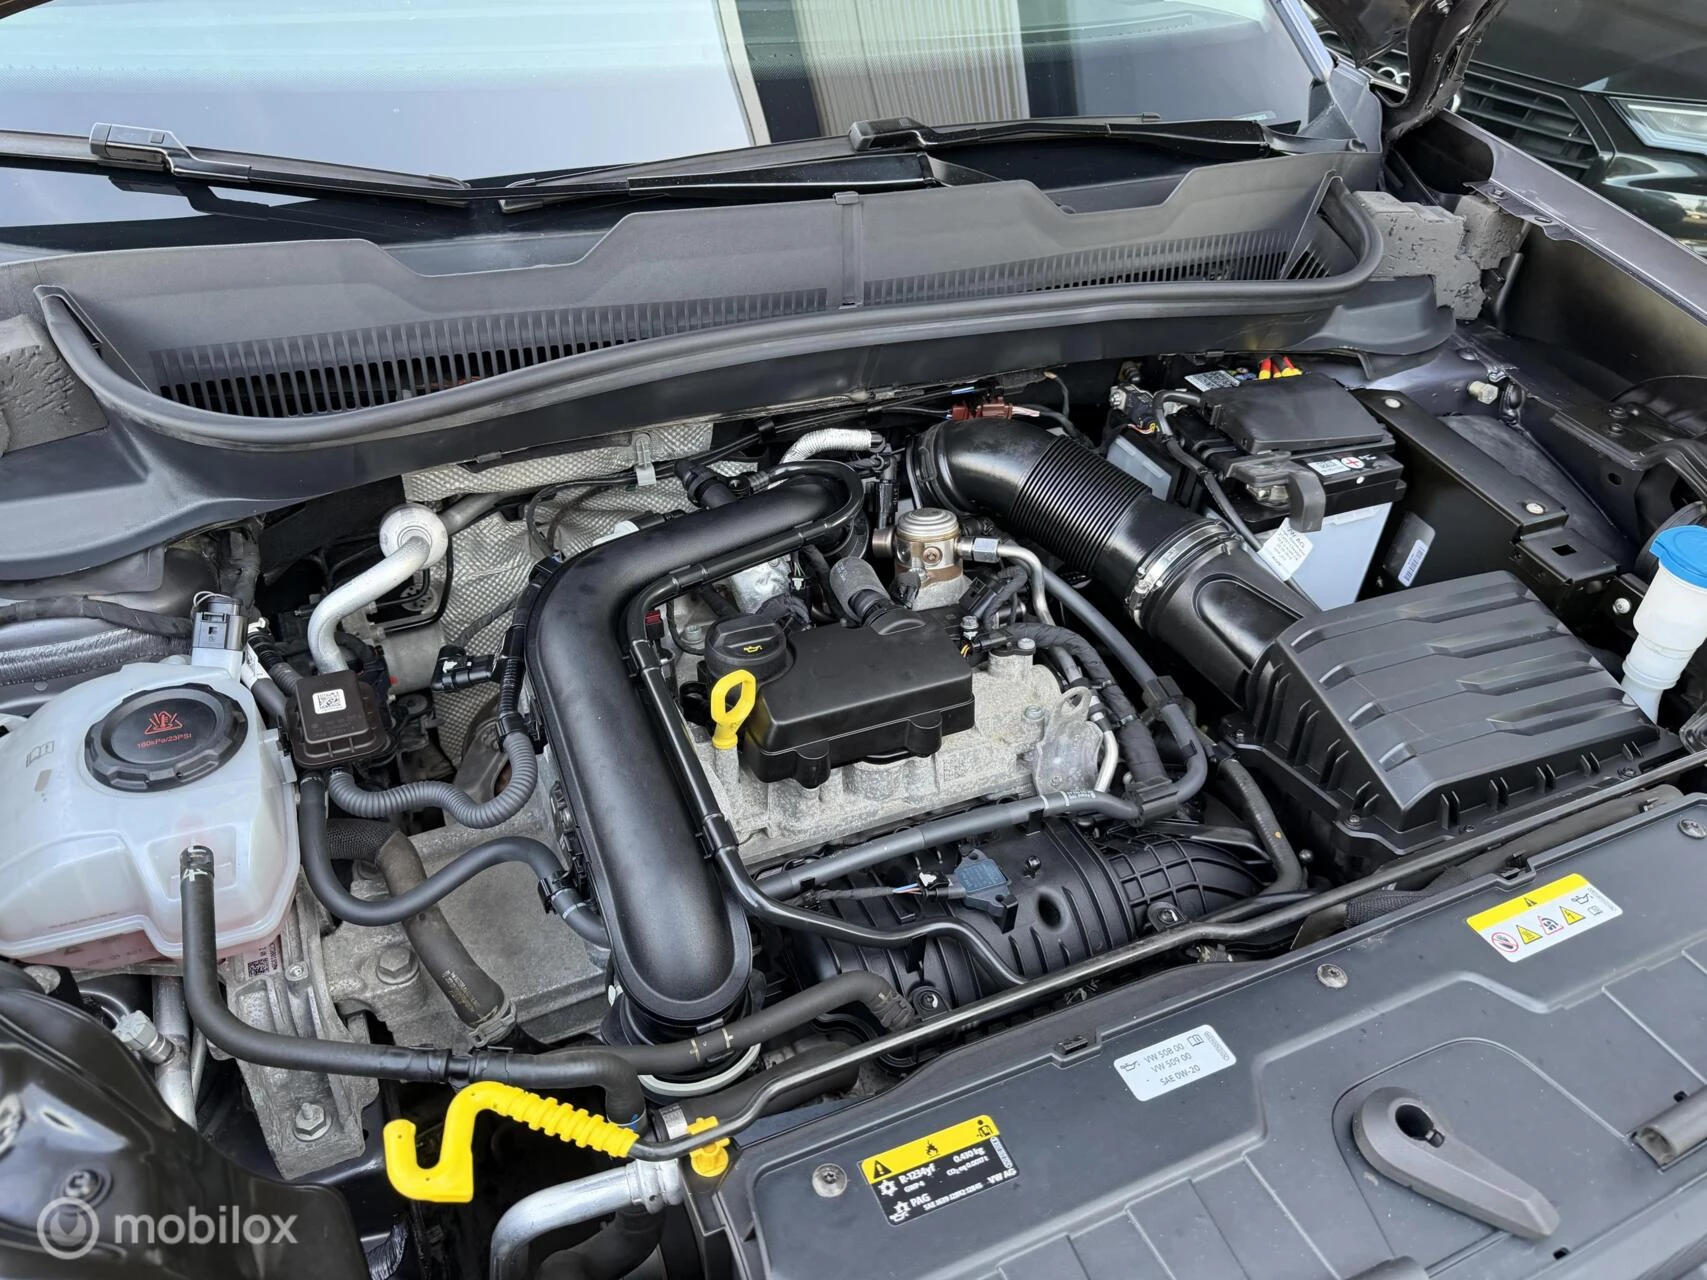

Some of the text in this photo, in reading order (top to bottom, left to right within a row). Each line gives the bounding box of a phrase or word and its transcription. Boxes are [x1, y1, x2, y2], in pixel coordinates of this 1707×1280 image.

[1144, 1043, 1185, 1063] VW 508 00
[1151, 1052, 1192, 1072] VW 509 00
[1160, 1064, 1201, 1086] SAE 0W-20
[972, 1146, 986, 1156] kg
[898, 1163, 936, 1184] R-1234yf
[987, 1168, 1017, 1184] VW AG
[910, 1193, 931, 1207] PAG
